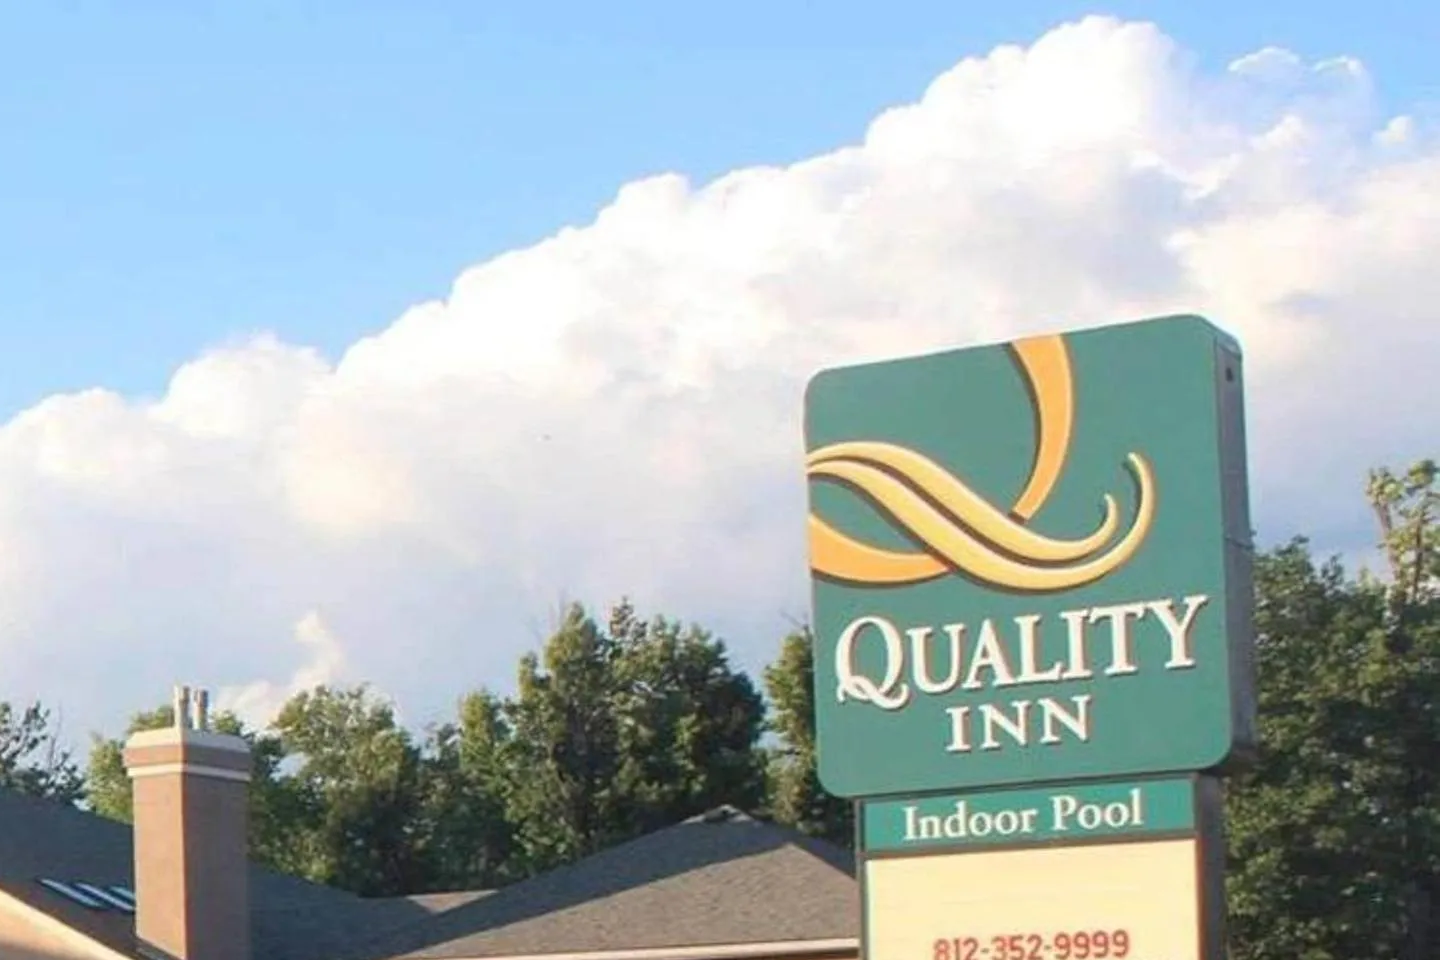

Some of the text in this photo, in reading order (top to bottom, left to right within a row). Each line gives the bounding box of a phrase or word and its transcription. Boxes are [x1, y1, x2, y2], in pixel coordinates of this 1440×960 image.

[835, 595, 1208, 709] QUALITY
[946, 696, 1091, 752] INN
[904, 789, 1143, 841] Indoor Pool
